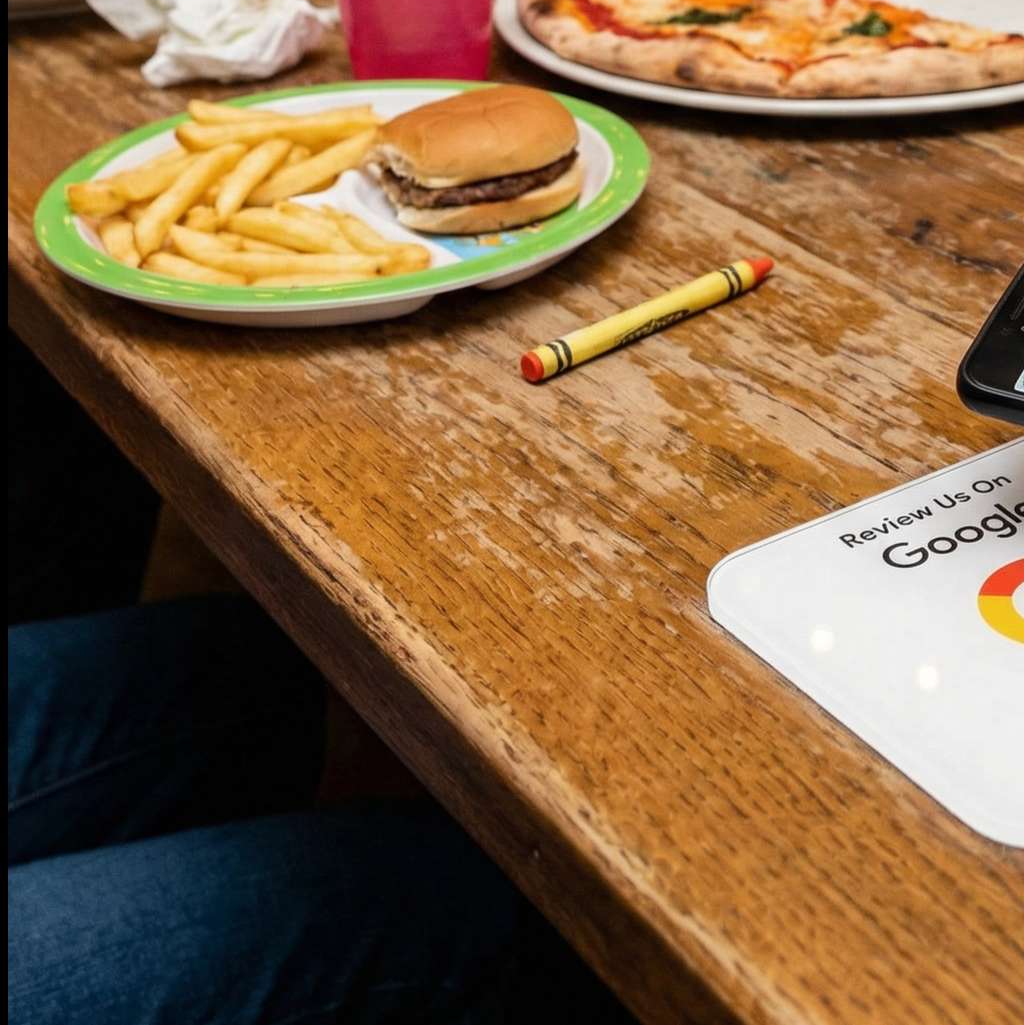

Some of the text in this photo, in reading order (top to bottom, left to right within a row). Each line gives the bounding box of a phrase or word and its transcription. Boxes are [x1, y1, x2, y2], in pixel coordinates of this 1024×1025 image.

[839, 475, 1013, 548] Review Us On
